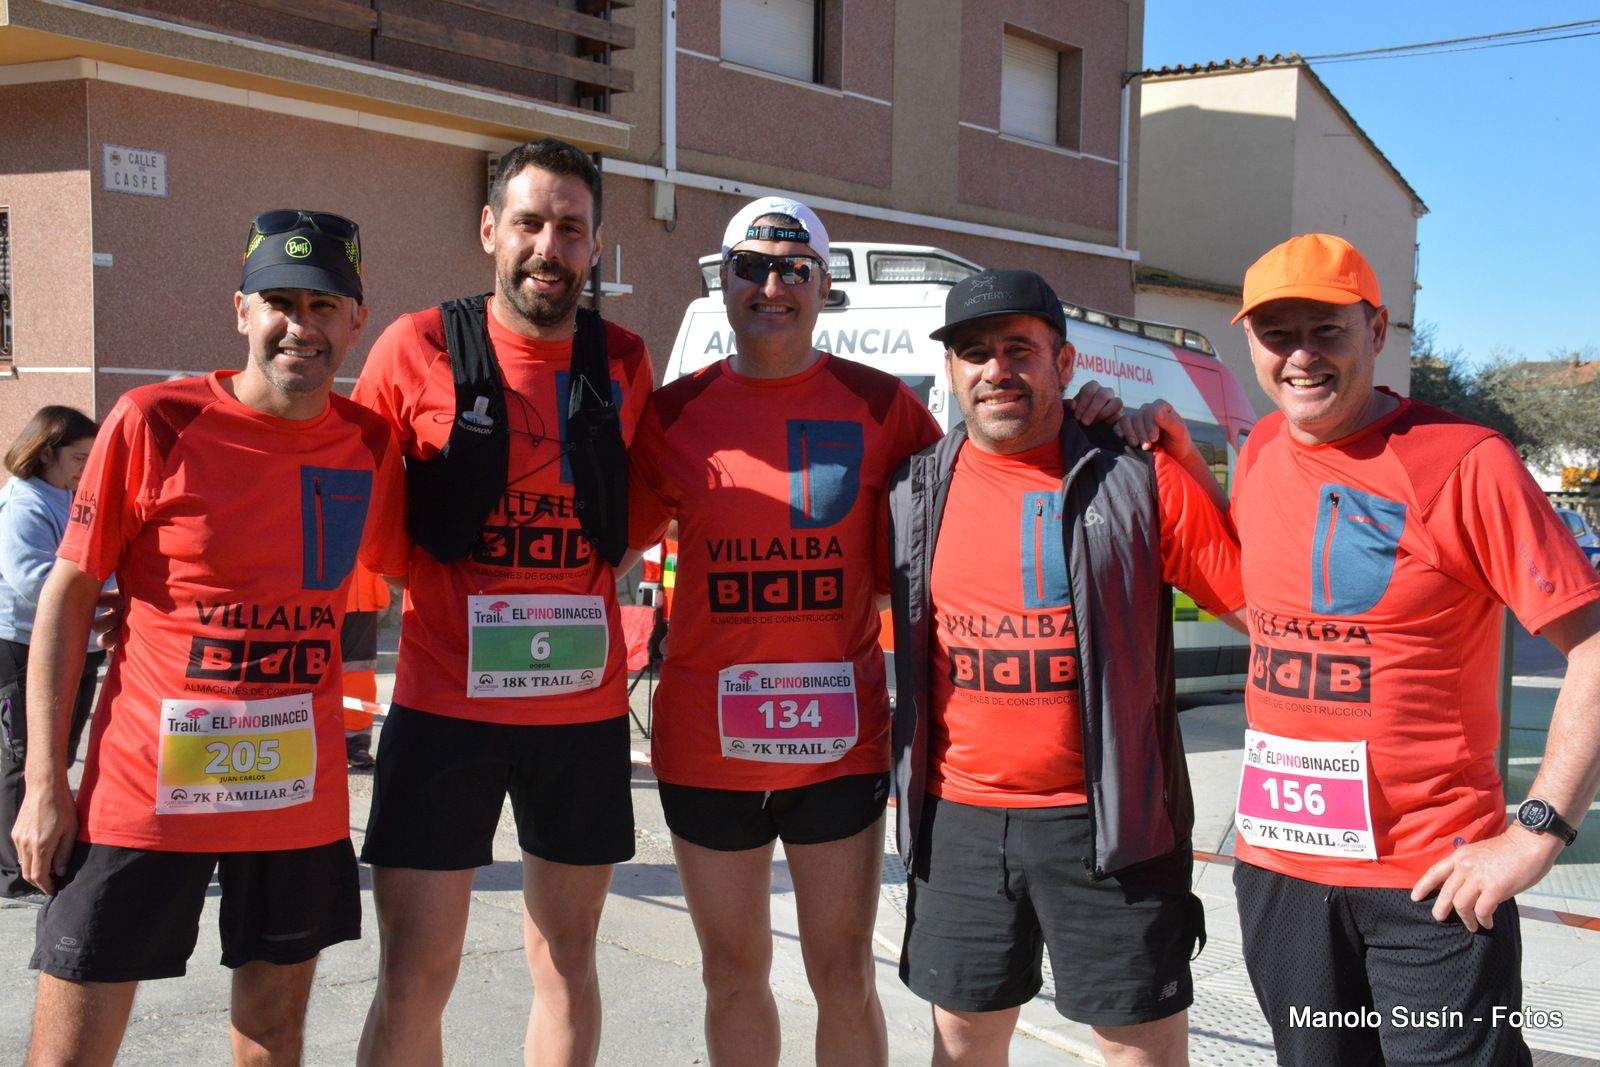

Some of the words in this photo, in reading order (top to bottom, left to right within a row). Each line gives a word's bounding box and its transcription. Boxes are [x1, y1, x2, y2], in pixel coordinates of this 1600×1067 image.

[128, 152, 157, 168] CALLE
[114, 171, 158, 191] CASPE
[1076, 352, 1155, 386] AMBULANCIA
[706, 535, 844, 563] VILLALBA
[524, 571, 538, 581] DE
[474, 611, 501, 624] Trail
[711, 615, 759, 625] ALMACENES
[760, 615, 773, 624] DE
[529, 631, 552, 662] 6
[184, 683, 250, 697] ALMACENES
[251, 686, 265, 697] DE
[502, 676, 529, 689] 18K
[530, 675, 575, 688] TRAIL
[724, 680, 750, 692] Trail
[992, 697, 1005, 706] DE
[757, 698, 823, 730] 134
[167, 717, 199, 733] Trail
[203, 738, 281, 775] 205
[752, 743, 773, 755] 7K
[775, 743, 827, 755] TRAIL
[1247, 748, 1263, 764] Trail
[218, 775, 239, 784] JUAN
[239, 773, 267, 782] CARLOS
[193, 792, 212, 804] 7K
[216, 787, 288, 803] FAMILIAR
[1261, 776, 1327, 817] 156
[1259, 824, 1279, 840] 7K
[1282, 828, 1337, 847] TRAIL
